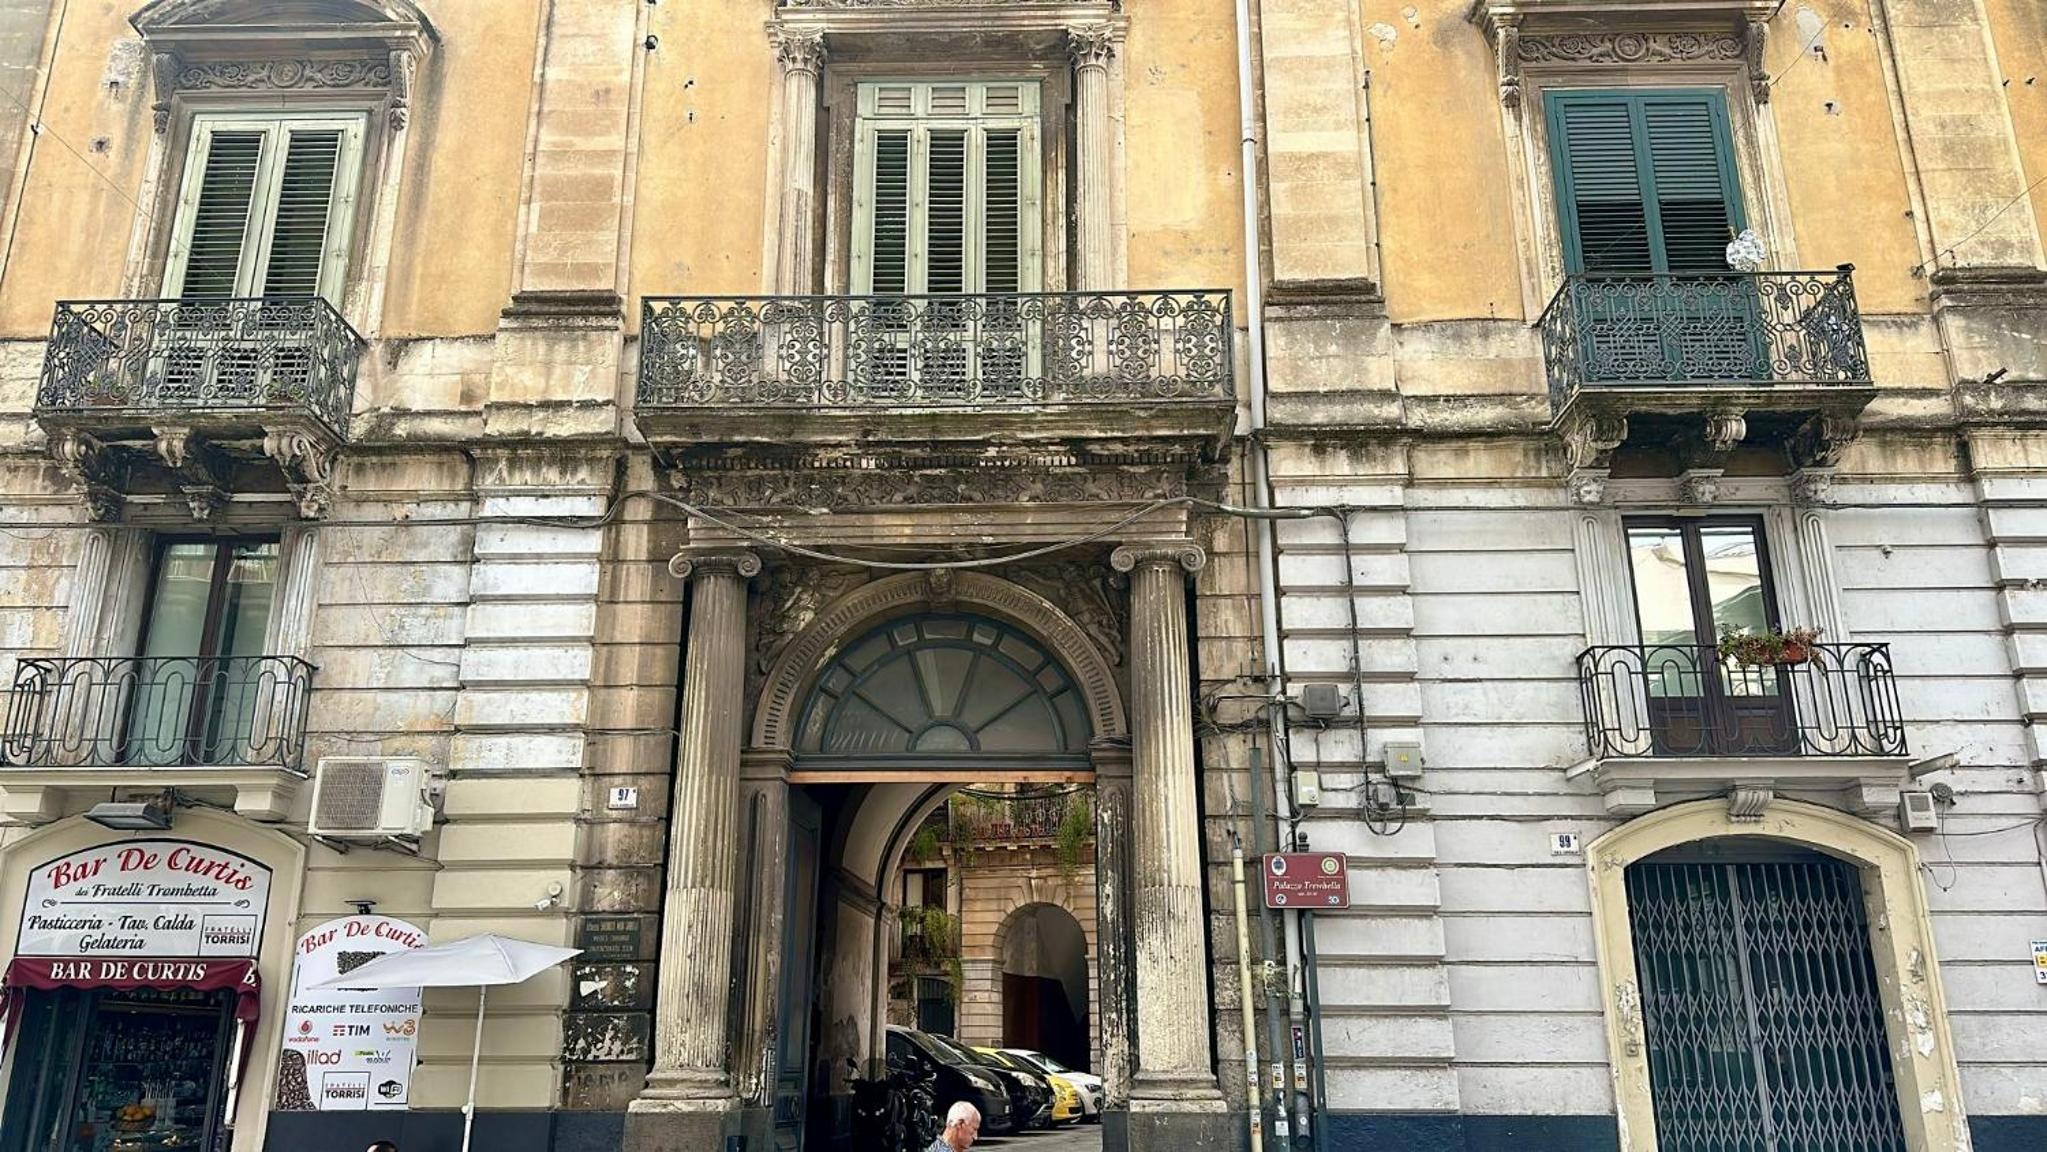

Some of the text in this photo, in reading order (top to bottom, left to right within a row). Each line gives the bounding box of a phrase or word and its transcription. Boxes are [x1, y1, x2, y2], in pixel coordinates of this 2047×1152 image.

[618, 788, 630, 801] 97
[1559, 834, 1571, 848] 99
[48, 847, 254, 890] Bar De Curtis
[75, 882, 219, 898] dei Fratelli Trombetta
[28, 914, 103, 931] Pasticceria
[117, 915, 149, 931] Tav.
[153, 914, 196, 931] Calda
[204, 926, 251, 934] FRATELLI
[79, 934, 146, 953] Gelateria
[204, 935, 250, 945] TORRISI
[301, 928, 338, 954] Bar
[343, 920, 371, 937] De
[50, 963, 207, 981] BAR DE CURTIS
[291, 1004, 419, 1014] RICARICHE TELEFONICHE
[347, 1025, 371, 1036] TIM
[306, 1049, 342, 1065] iliad
[325, 1090, 365, 1099] TORRISI
